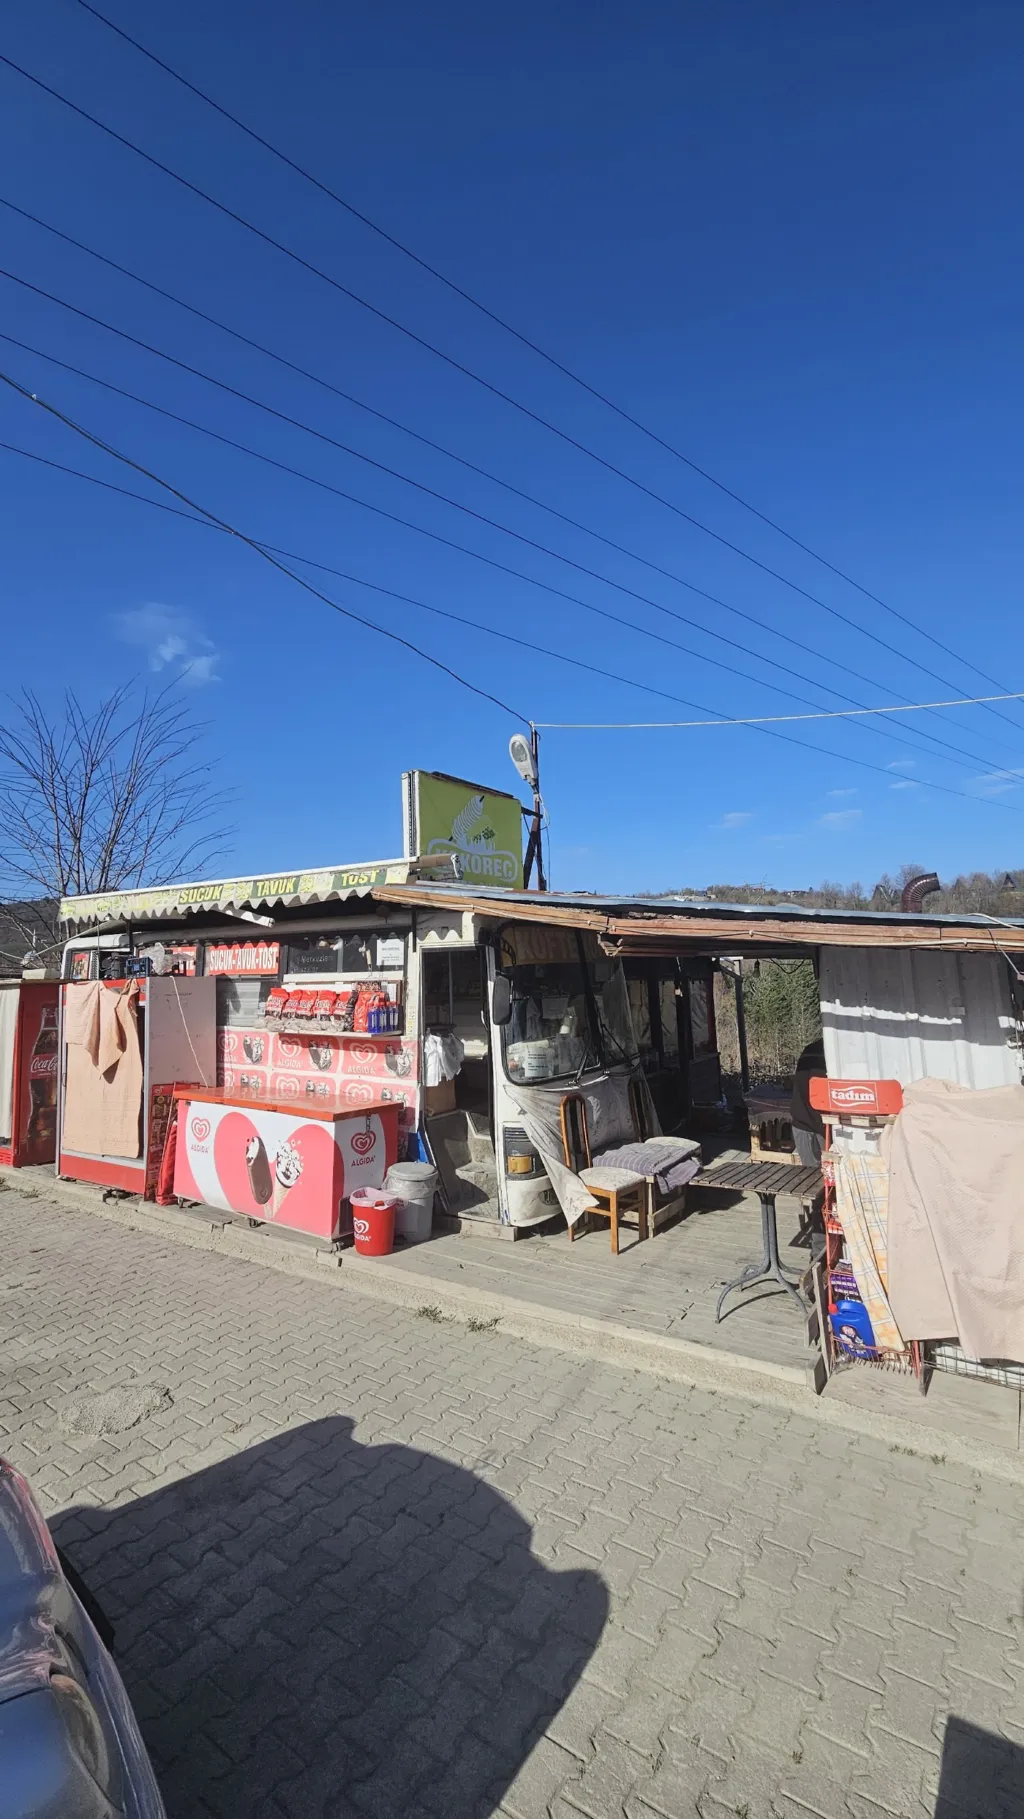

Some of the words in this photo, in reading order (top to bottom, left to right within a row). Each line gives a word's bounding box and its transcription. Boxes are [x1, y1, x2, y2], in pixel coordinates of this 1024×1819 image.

[178, 885, 223, 904] SUCUK
[256, 877, 296, 897] TAVUK
[341, 869, 380, 887] TOST
[277, 1058, 303, 1068] ALGIDA
[347, 1065, 376, 1075] ALGIDA
[830, 1089, 876, 1101] tadım
[351, 1156, 375, 1168] ALGIDA
